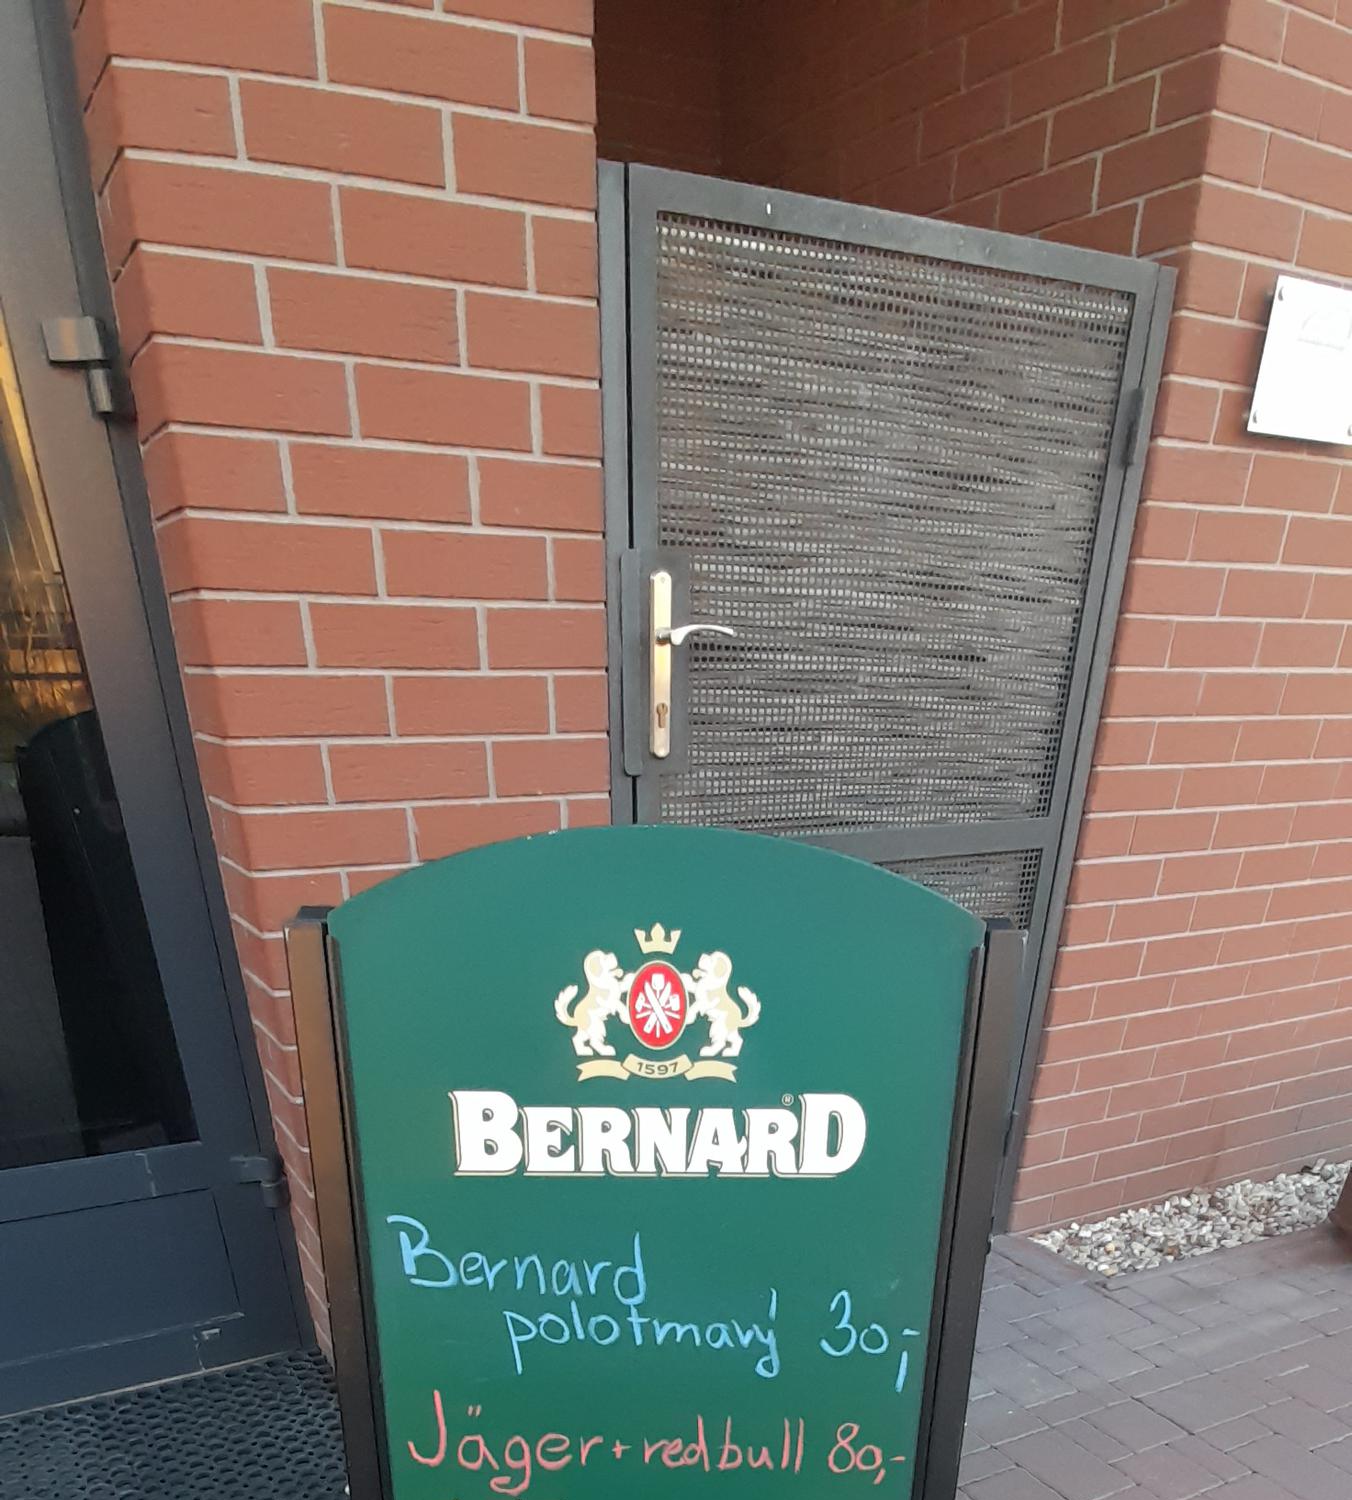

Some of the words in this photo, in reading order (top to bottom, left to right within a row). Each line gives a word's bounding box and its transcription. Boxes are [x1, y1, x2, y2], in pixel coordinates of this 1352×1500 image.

[635, 1060, 680, 1077] 1597
[448, 1090, 867, 1178] BERNARD
[386, 1215, 647, 1305] Bernard
[819, 1289, 921, 1393] 30,-
[827, 1423, 906, 1485] 80,-
